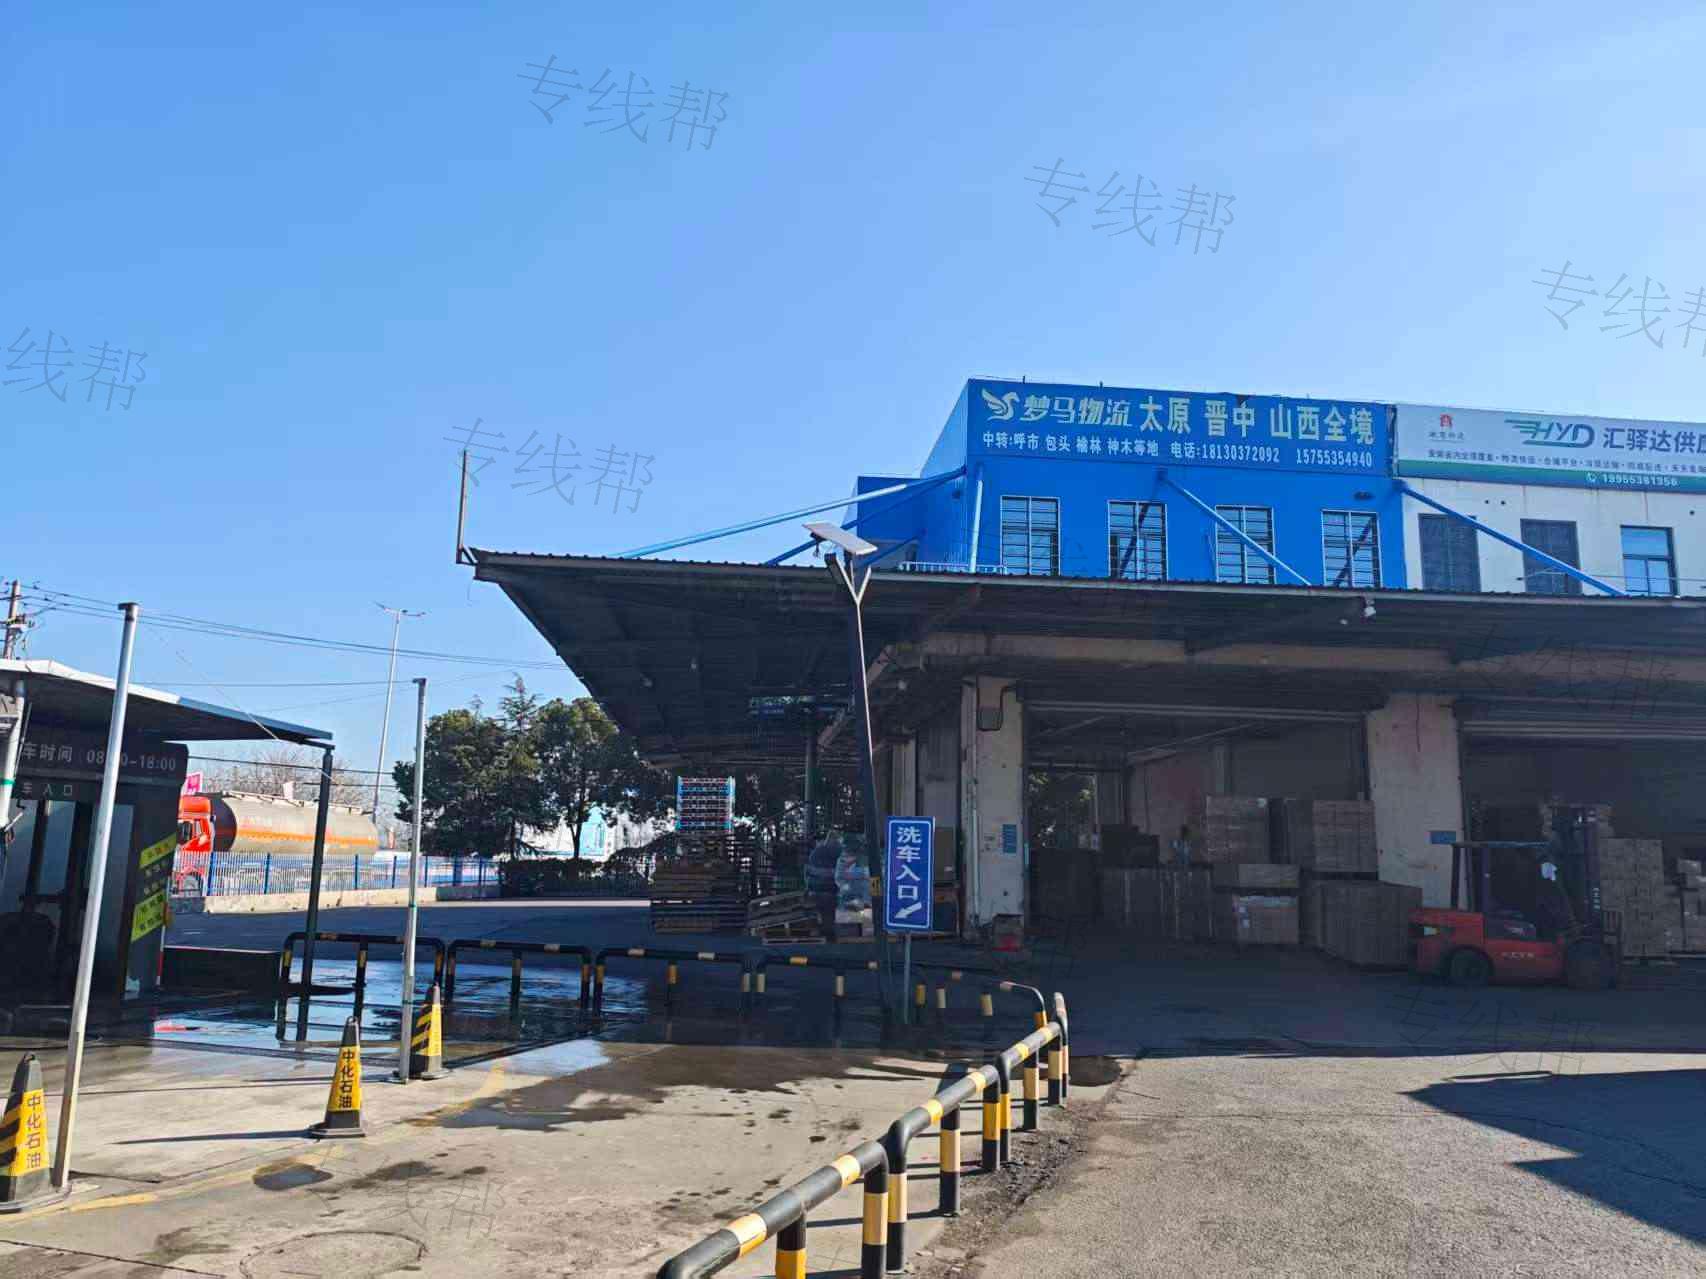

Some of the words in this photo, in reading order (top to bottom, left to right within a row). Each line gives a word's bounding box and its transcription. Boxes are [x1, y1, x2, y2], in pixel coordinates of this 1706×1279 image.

[1020, 395, 1133, 428] 梦马物流
[1139, 396, 1191, 436] 太原
[1203, 398, 1256, 438] 晋中
[1269, 402, 1375, 446] 山西全境
[1044, 434, 1071, 452] 包头
[1075, 435, 1102, 455] 榆林
[1106, 437, 1159, 458] 神木等地
[1529, 420, 1594, 450] HYD
[896, 826, 922, 901] 洗车入口
[338, 1047, 354, 1111] 中化石油
[25, 1093, 42, 1169] 中化石油
